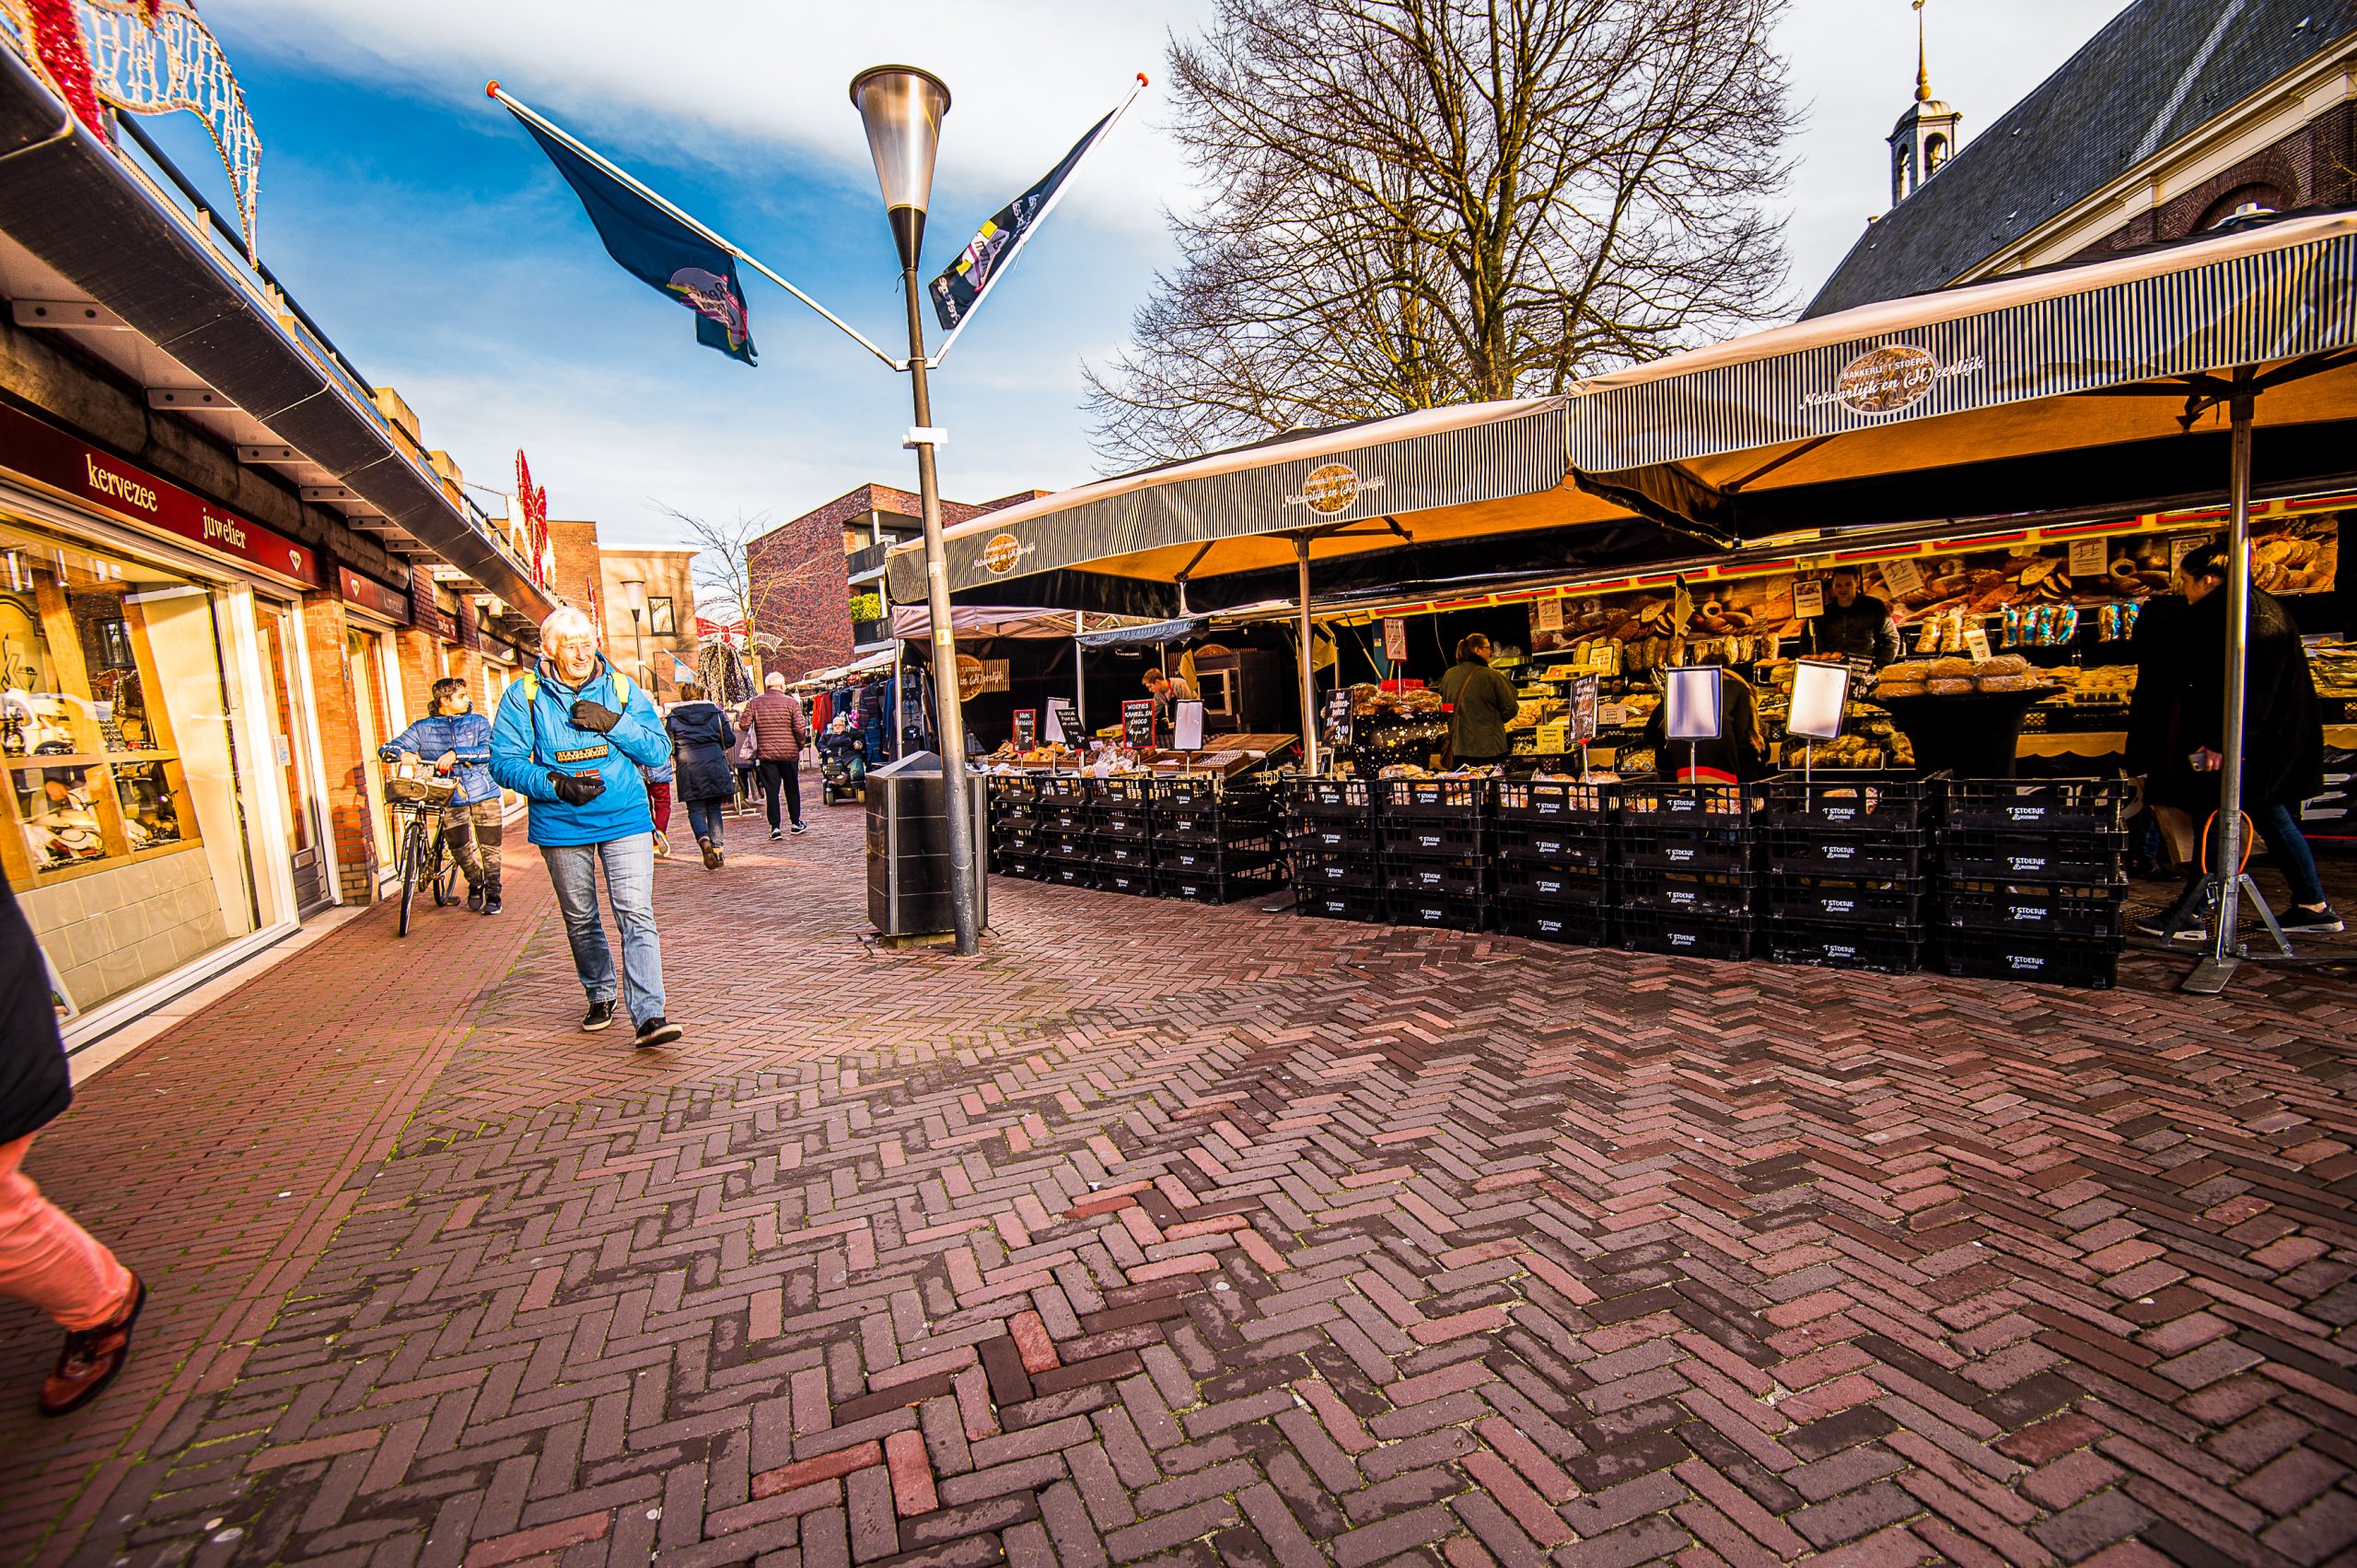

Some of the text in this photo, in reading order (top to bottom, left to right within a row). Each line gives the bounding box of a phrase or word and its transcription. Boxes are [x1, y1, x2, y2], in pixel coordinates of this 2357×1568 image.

[1843, 366, 1883, 379] BAKKERIJ
[1894, 356, 1930, 370] STOEPJE
[1799, 379, 1879, 410] Natuurlijk
[1882, 377, 1899, 390] en
[86, 453, 157, 512] kervezee
[203, 507, 246, 550] juwelier
